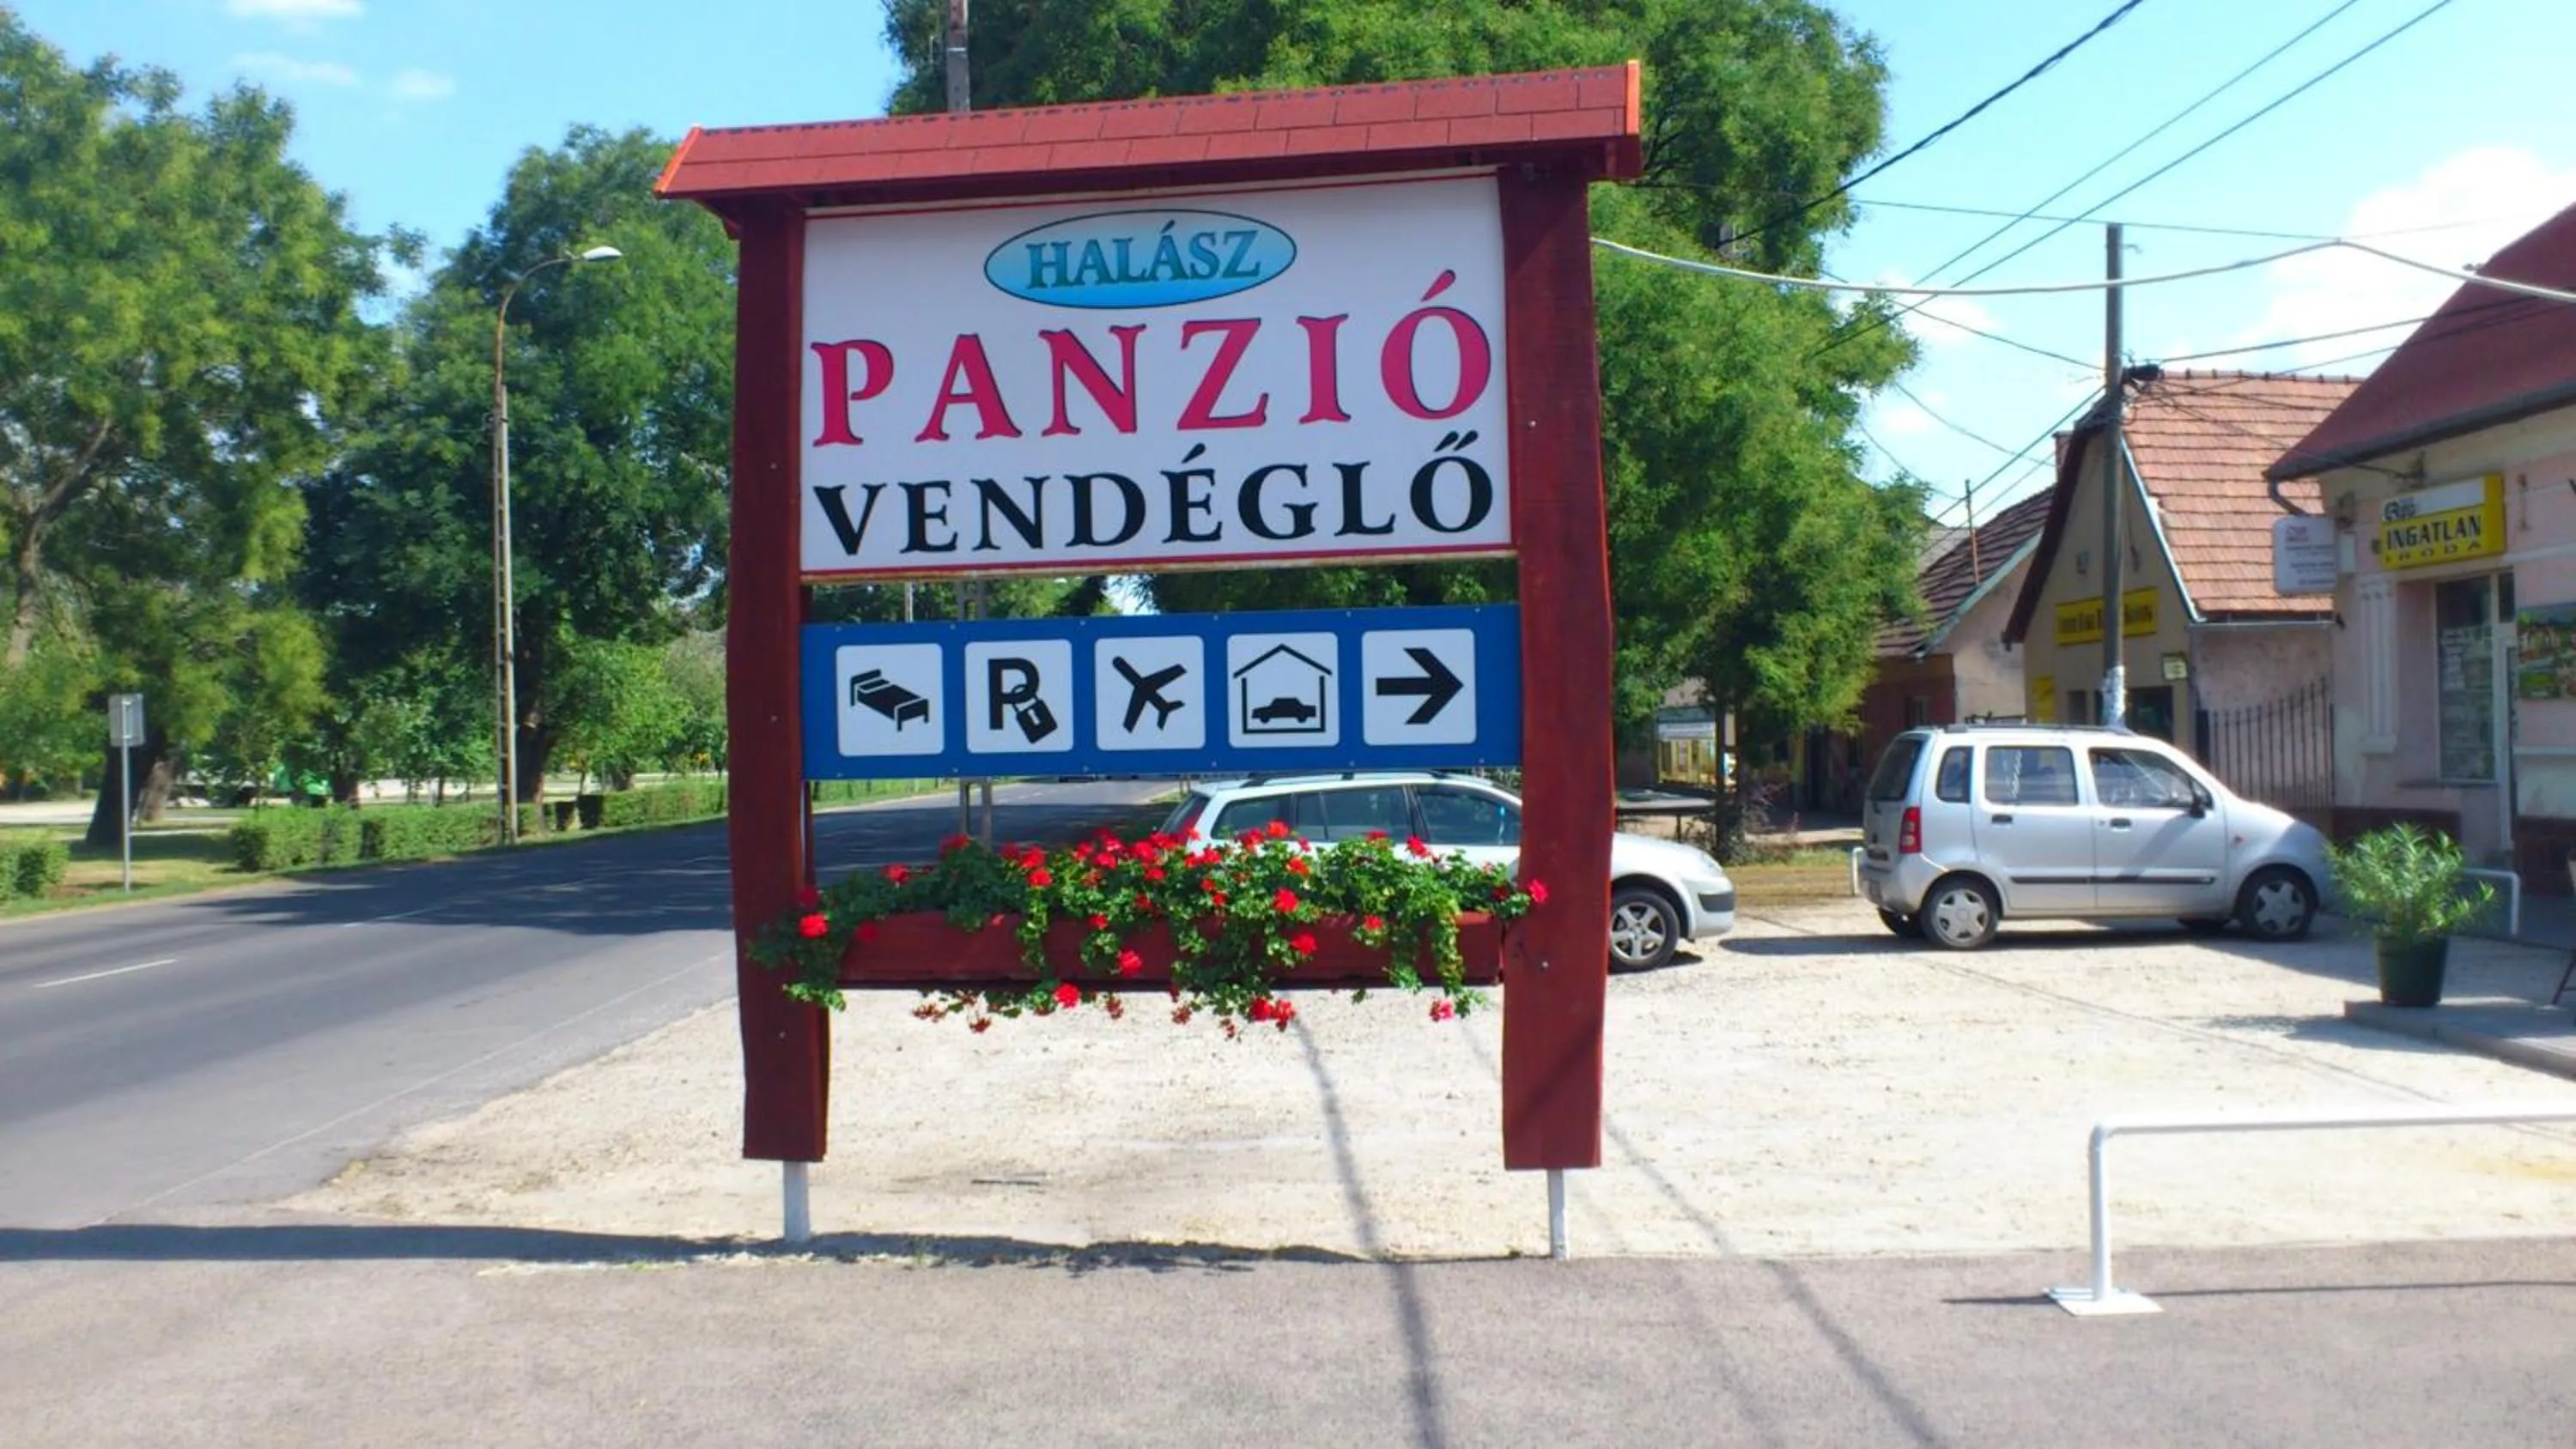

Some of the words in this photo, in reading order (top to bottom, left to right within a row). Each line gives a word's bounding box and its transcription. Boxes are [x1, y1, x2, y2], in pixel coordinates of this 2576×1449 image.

[1025, 220, 1261, 288] HALÁSZ
[811, 270, 1492, 446] PANZIÓ
[813, 431, 1494, 555] VENDÉGLŐ
[2387, 515, 2482, 550] INGATLAN
